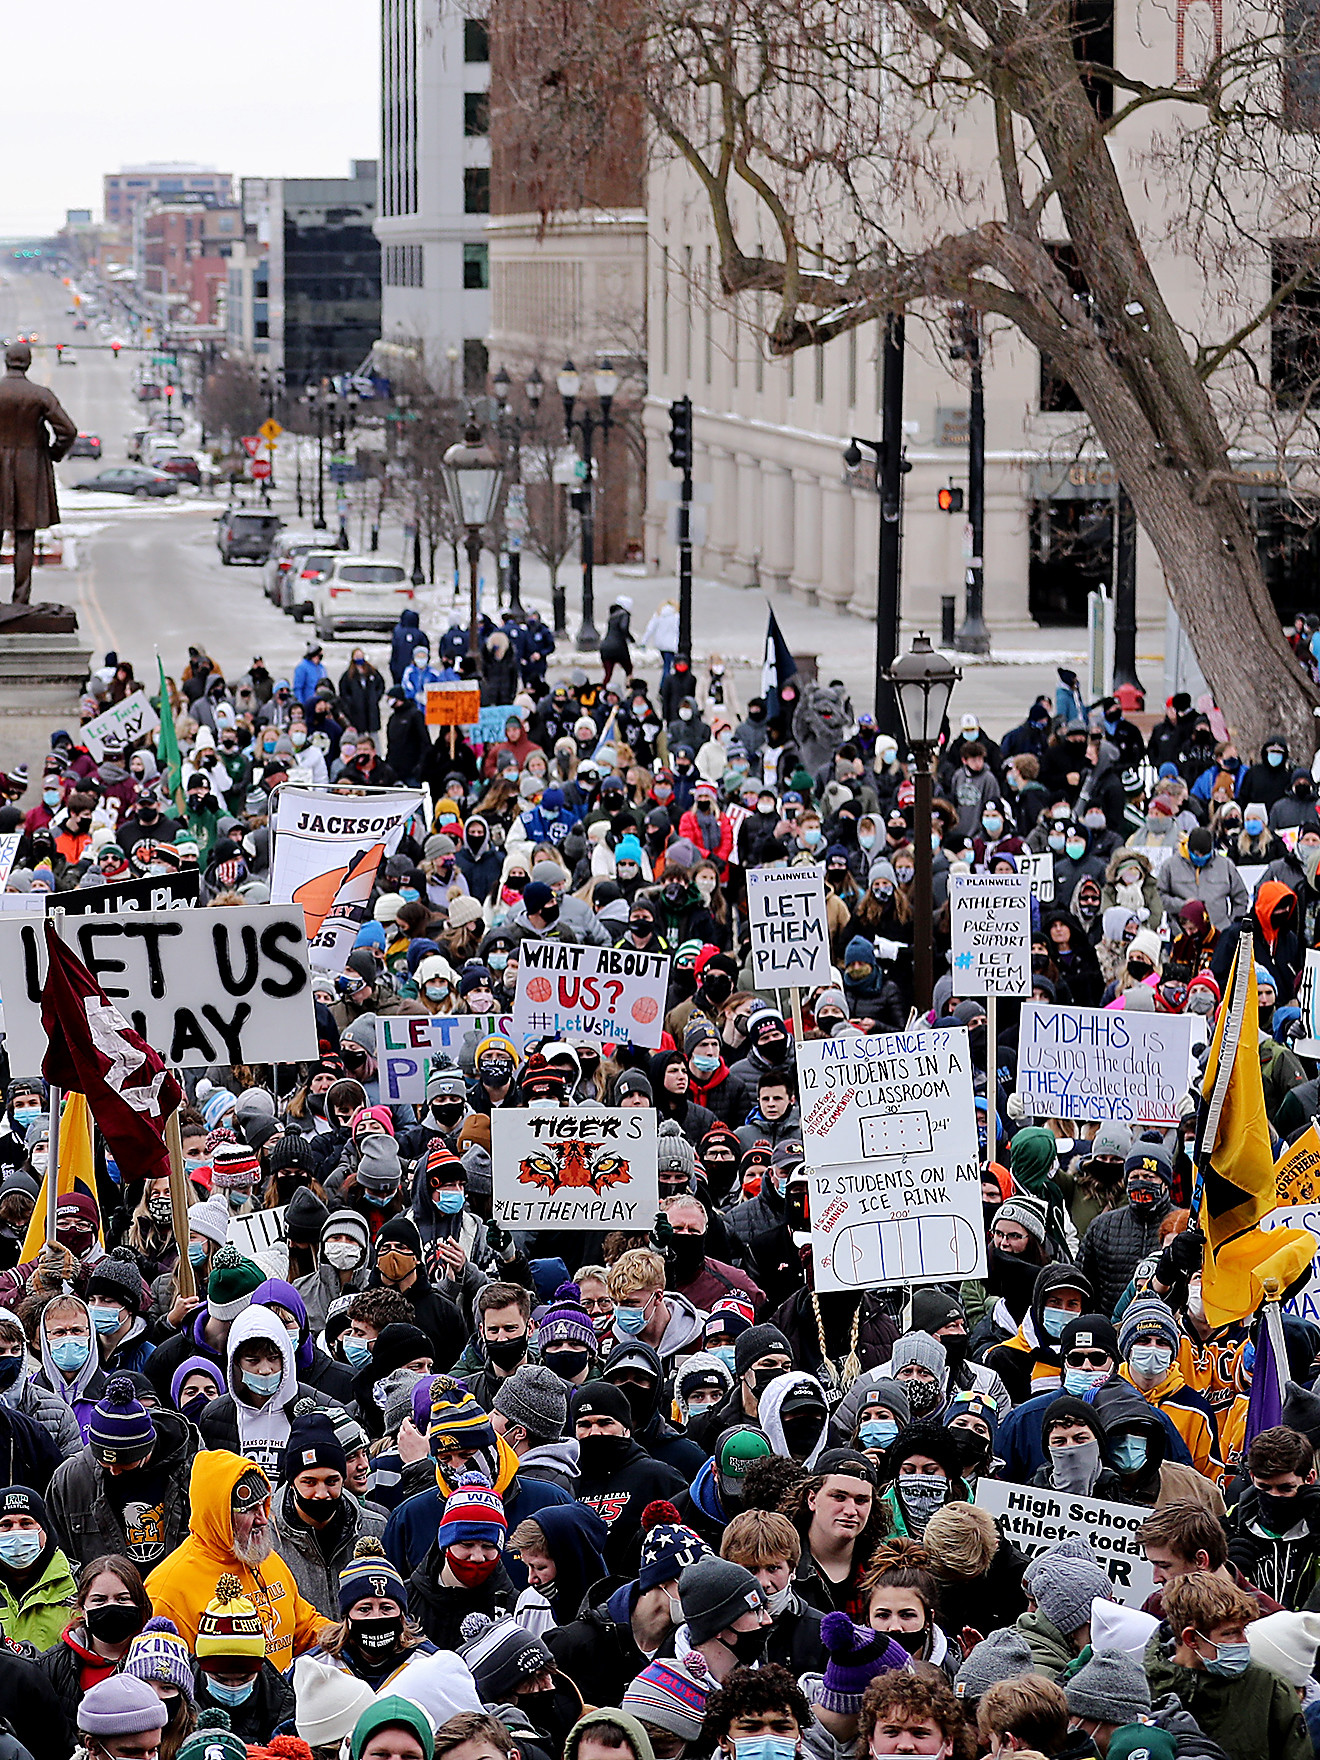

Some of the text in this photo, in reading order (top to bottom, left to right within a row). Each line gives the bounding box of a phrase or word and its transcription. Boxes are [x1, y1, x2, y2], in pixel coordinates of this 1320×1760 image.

[86, 702, 141, 741] LET THEM
[100, 711, 144, 748] PLAY
[297, 812, 404, 837] JACKSON
[764, 871, 819, 883] PLAINWELL
[966, 879, 1022, 887] PLAINWELL
[764, 892, 817, 918] LET
[957, 896, 1027, 910] ATHLETES
[986, 909, 996, 922] &
[753, 919, 823, 944] THEM
[964, 920, 1020, 934] PARENTS
[972, 933, 1026, 947] SUPPORT
[211, 920, 309, 999] US
[522, 941, 670, 979] WHAT ABOUT
[756, 946, 819, 972] PLAY
[979, 952, 1012, 966] LET
[975, 966, 1023, 979] THEM
[557, 975, 625, 1014] US?
[984, 979, 1026, 994] PLAY
[131, 1002, 253, 1067] LAY
[383, 1017, 460, 1050] LET
[527, 1011, 631, 1042] #LetUsPlay
[1033, 1011, 1130, 1049] MDHHS
[821, 1040, 847, 1061] MI
[853, 1033, 926, 1059] SCIENCE
[802, 1053, 963, 1090] 12 STUDENTS IN A
[1092, 1049, 1163, 1078] the data
[855, 1079, 950, 1109] CLASSROOM
[1021, 1070, 1074, 1095] THEY
[1154, 1078, 1176, 1102] to
[1022, 1091, 1056, 1116] Prove
[527, 1114, 643, 1140] TIGERS
[1142, 1157, 1157, 1171] M
[815, 1161, 979, 1197] 12 STUDENTS ON AN
[494, 1199, 639, 1223] #LETTHEMPLAY
[858, 1186, 952, 1215] ICE RINK
[822, 1200, 850, 1235] BANNED
[554, 1321, 568, 1334] A
[1008, 1491, 1063, 1518] High
[368, 1576, 388, 1597] T
